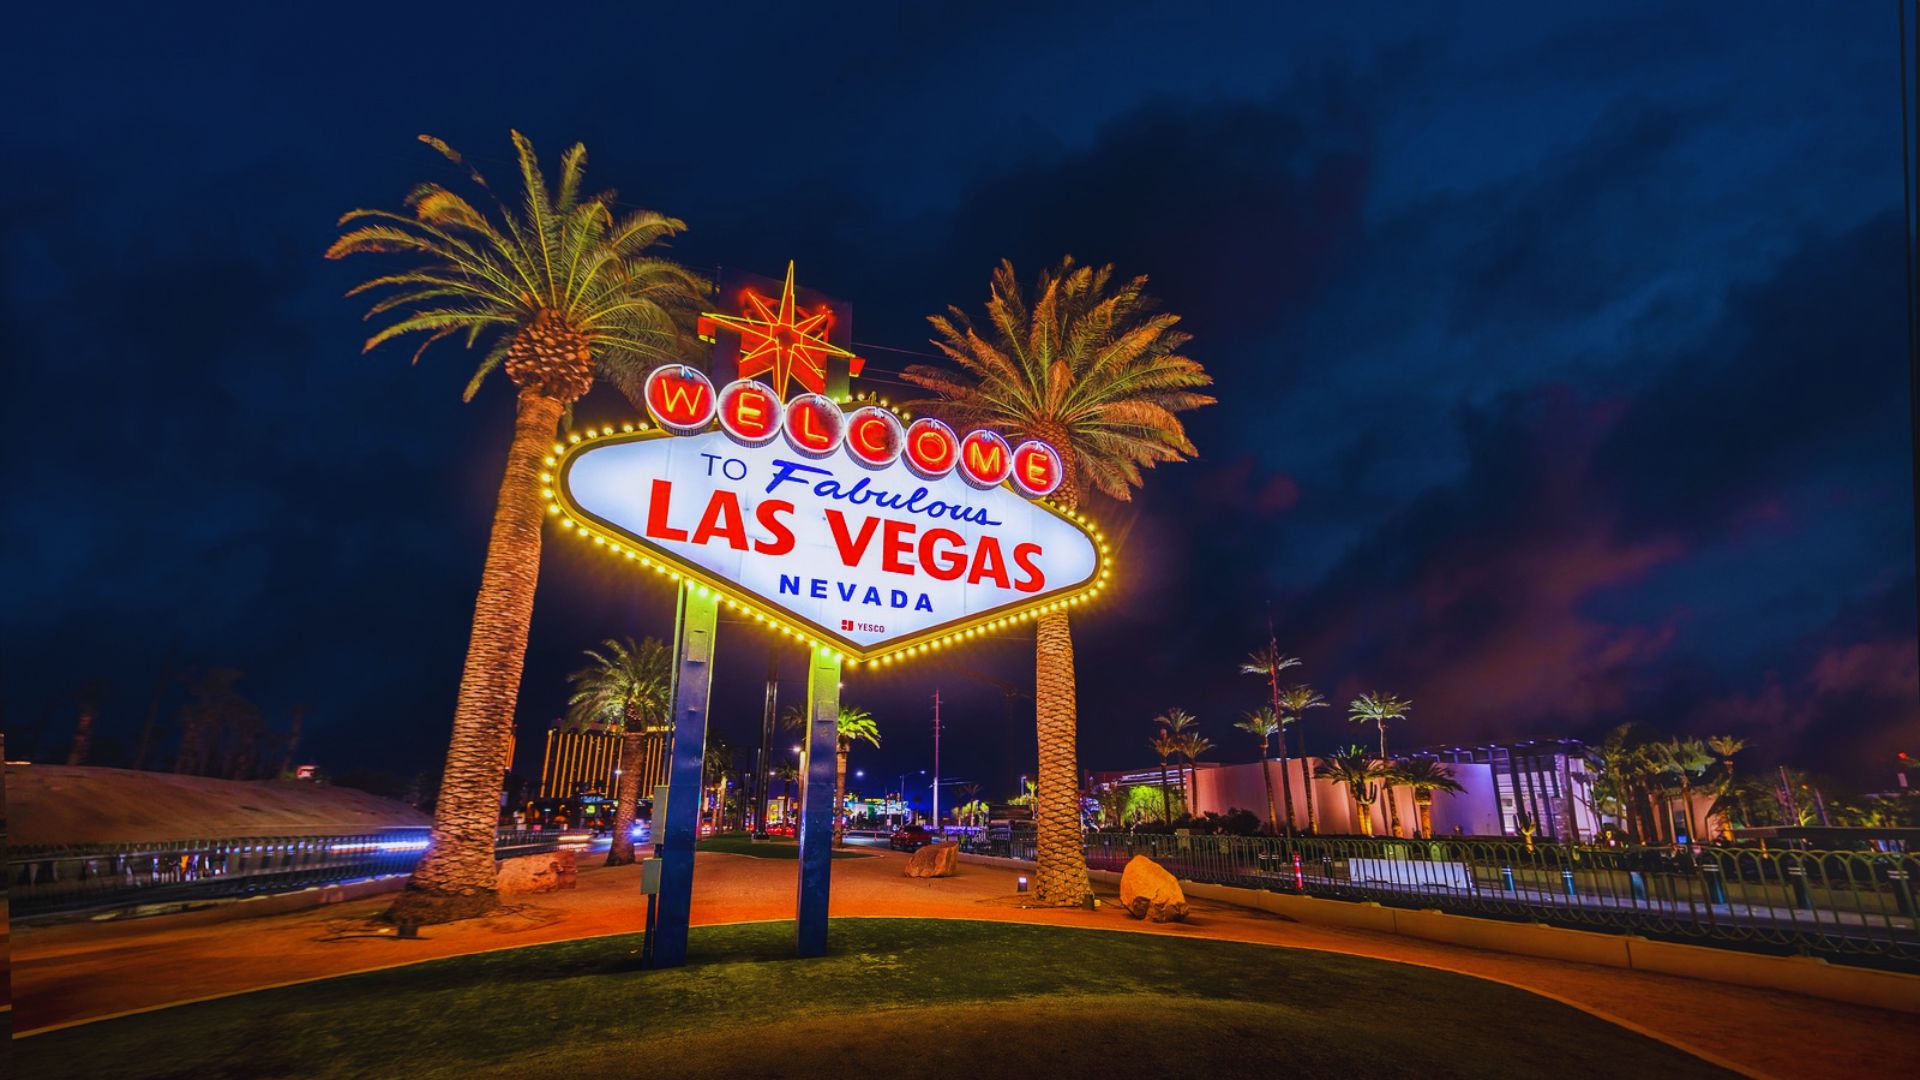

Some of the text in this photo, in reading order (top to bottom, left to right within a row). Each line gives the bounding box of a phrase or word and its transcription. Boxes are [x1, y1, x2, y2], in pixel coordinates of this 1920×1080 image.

[661, 378, 1047, 485] WELCOME
[701, 453, 1003, 526] TO Fabulous
[646, 479, 1046, 593] LAS VEGAS
[779, 574, 934, 613] NEVADA
[857, 622, 885, 633] YESCO
